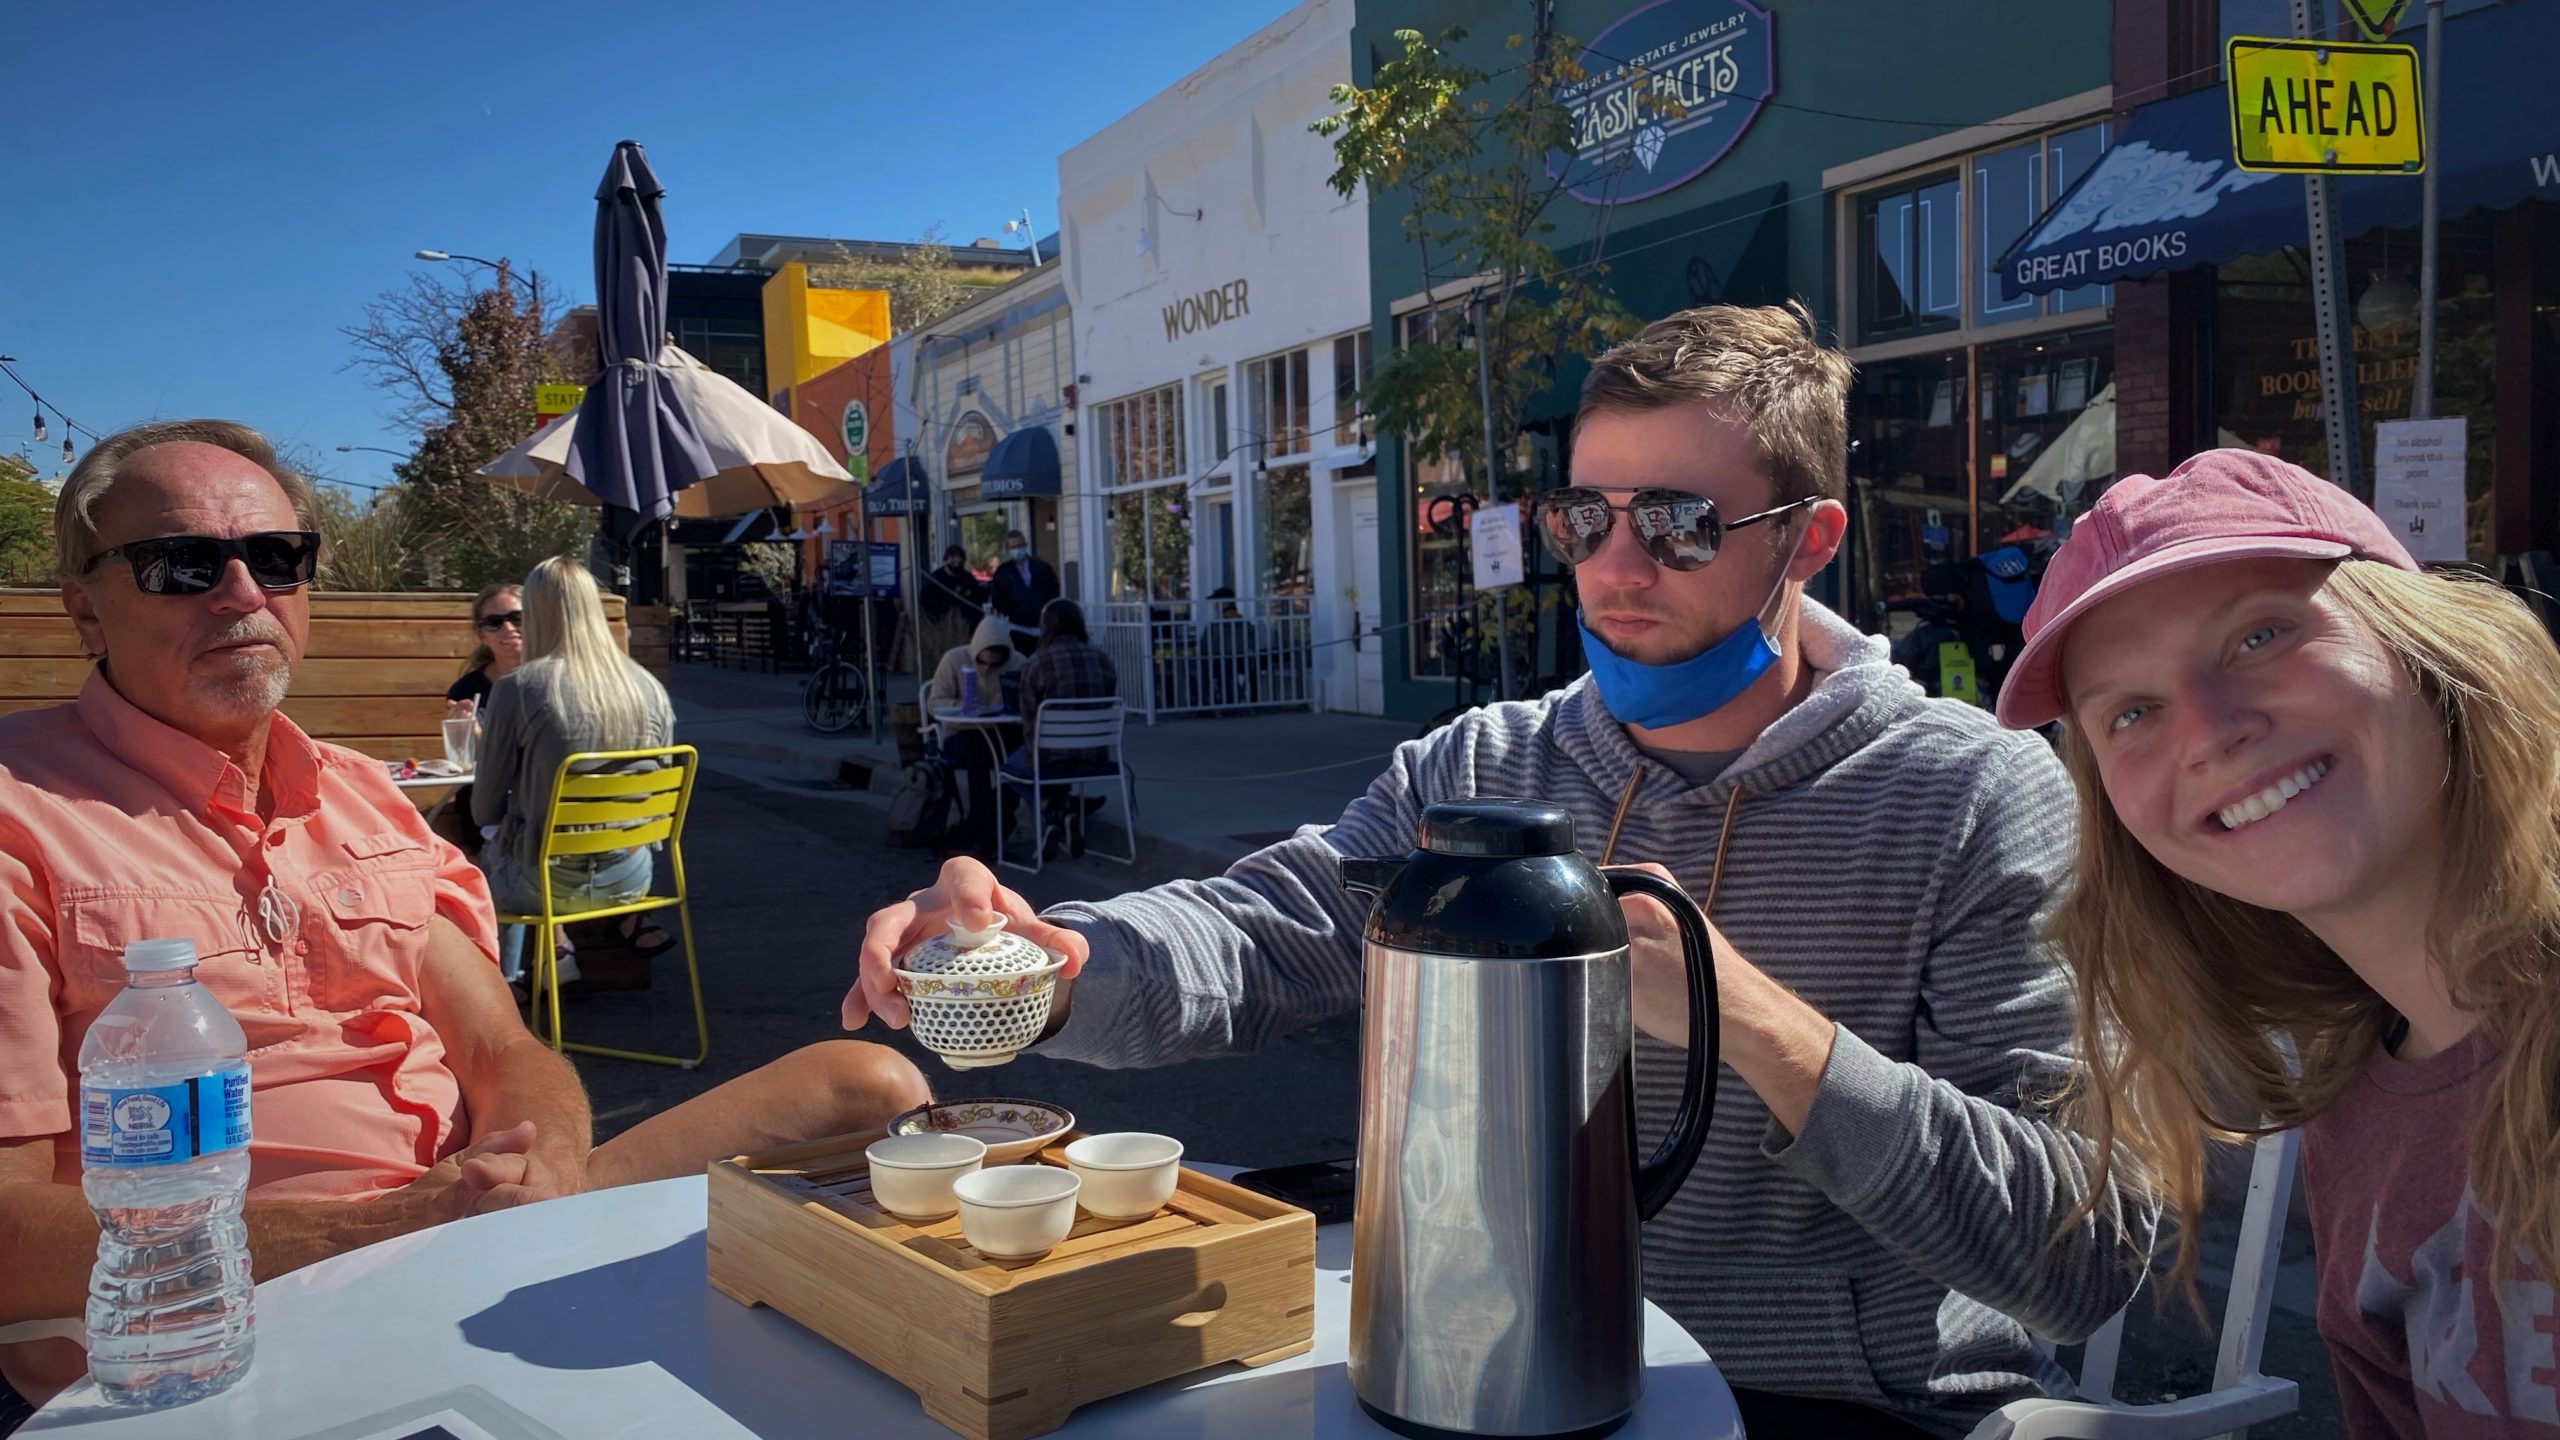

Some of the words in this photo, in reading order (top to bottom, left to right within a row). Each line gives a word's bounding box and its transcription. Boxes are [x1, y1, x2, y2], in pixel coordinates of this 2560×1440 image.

[1629, 41, 1677, 70] ESTATE
[1681, 11, 1747, 48] JEWELRY
[1652, 45, 1739, 120] FACETS
[2258, 77, 2398, 138] AHEAD
[2017, 249, 2091, 284] GREAT
[2098, 231, 2187, 270] BOOKS
[1162, 278, 1250, 343] WONDER
[2291, 321, 2403, 360] TRENT
[223, 1073, 248, 1088] Purified
[223, 1087, 244, 1100] Water
